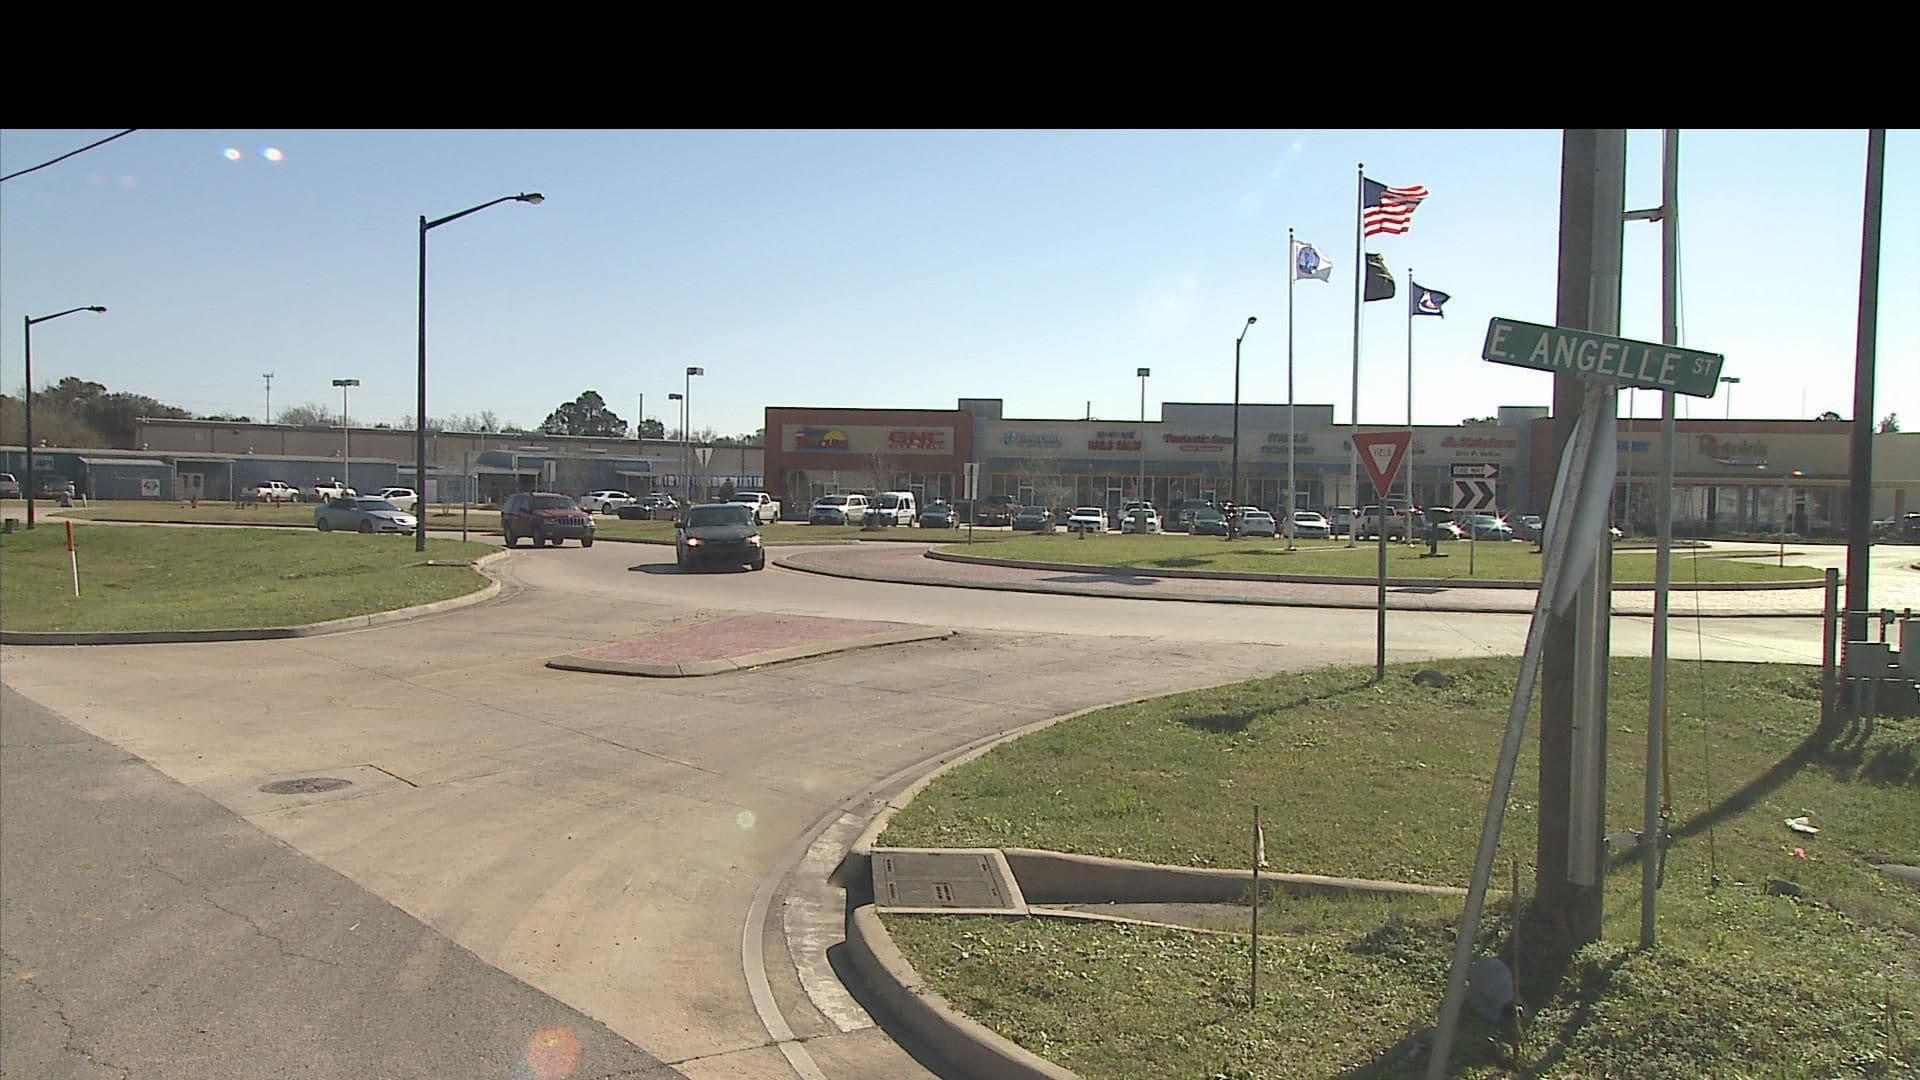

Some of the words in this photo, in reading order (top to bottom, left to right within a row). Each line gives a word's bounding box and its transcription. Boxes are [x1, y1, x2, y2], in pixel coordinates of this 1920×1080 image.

[1489, 324, 1516, 360] E.
[1529, 332, 1682, 386] ANGELLE
[1692, 357, 1717, 376] ST
[1373, 448, 1392, 457] YIELD
[1455, 466, 1469, 474] ONE
[1470, 466, 1484, 474] WAY
